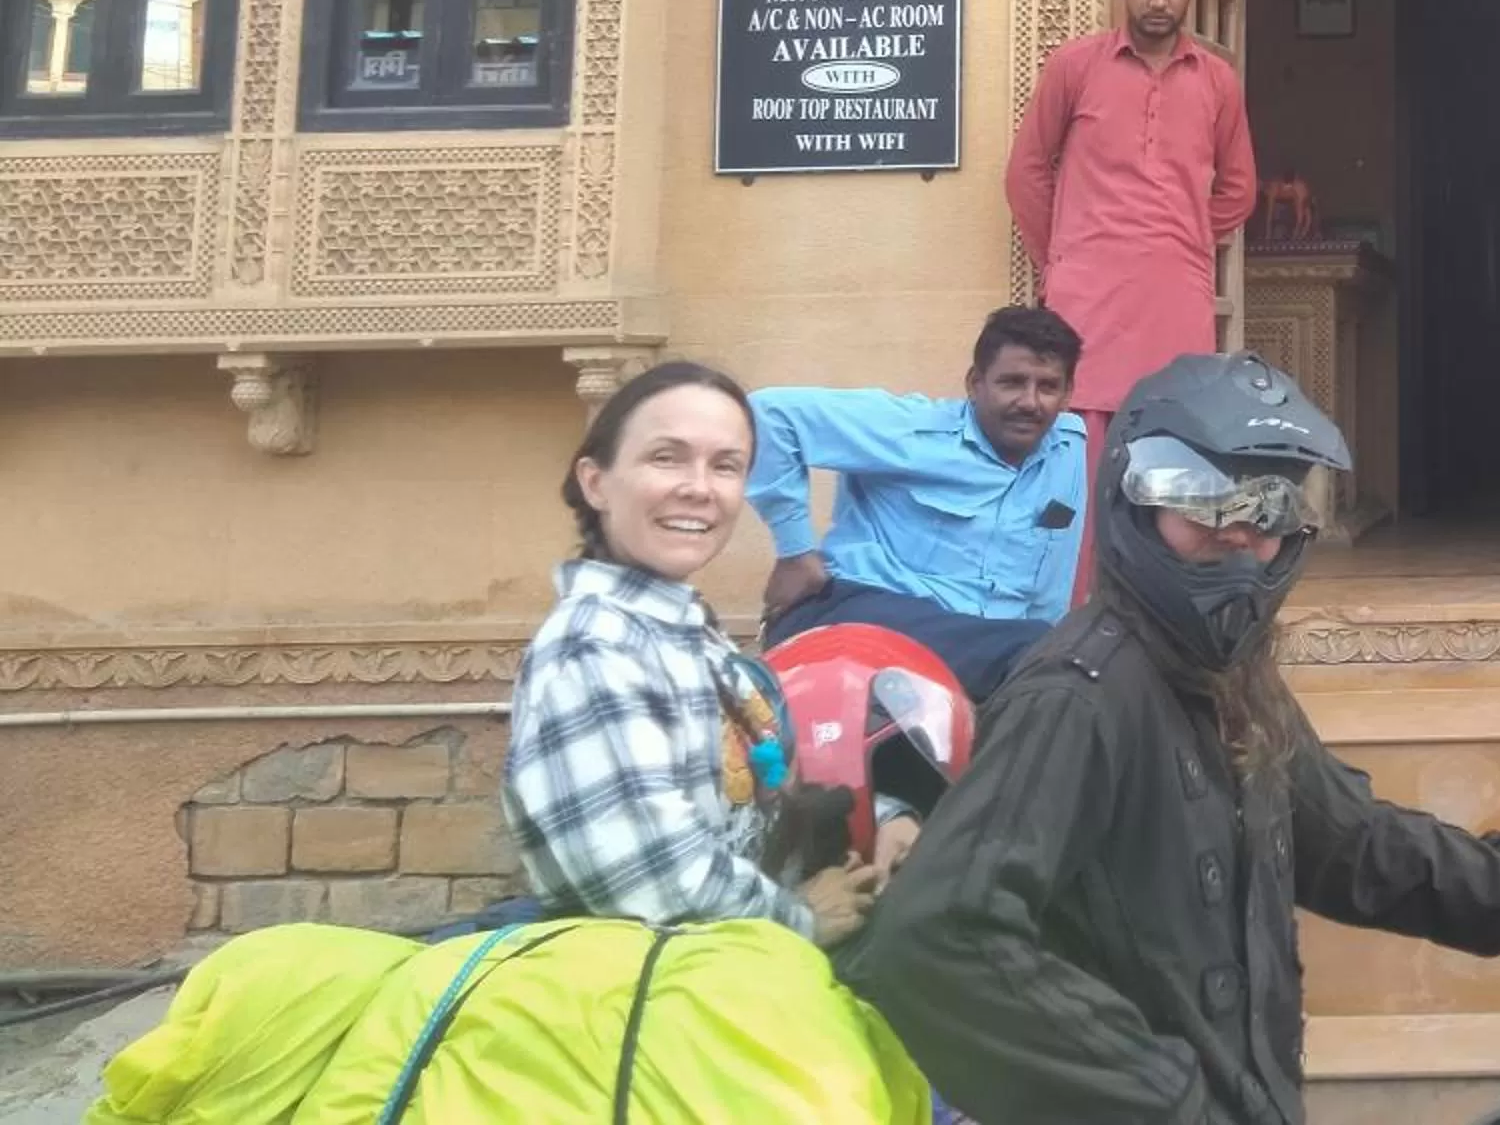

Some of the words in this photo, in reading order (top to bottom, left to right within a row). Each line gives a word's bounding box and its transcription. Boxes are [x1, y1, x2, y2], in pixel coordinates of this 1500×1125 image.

[747, 8, 783, 32] A/C
[787, 8, 801, 30] &
[889, 4, 945, 27] ROOM
[772, 34, 926, 62] AVAILABLE
[825, 70, 876, 84] WITH
[752, 98, 796, 120] ROOF
[800, 98, 831, 120] TOP
[834, 97, 938, 120] RESTAURANT
[795, 134, 851, 151] WITH
[858, 132, 906, 150] WIFI
